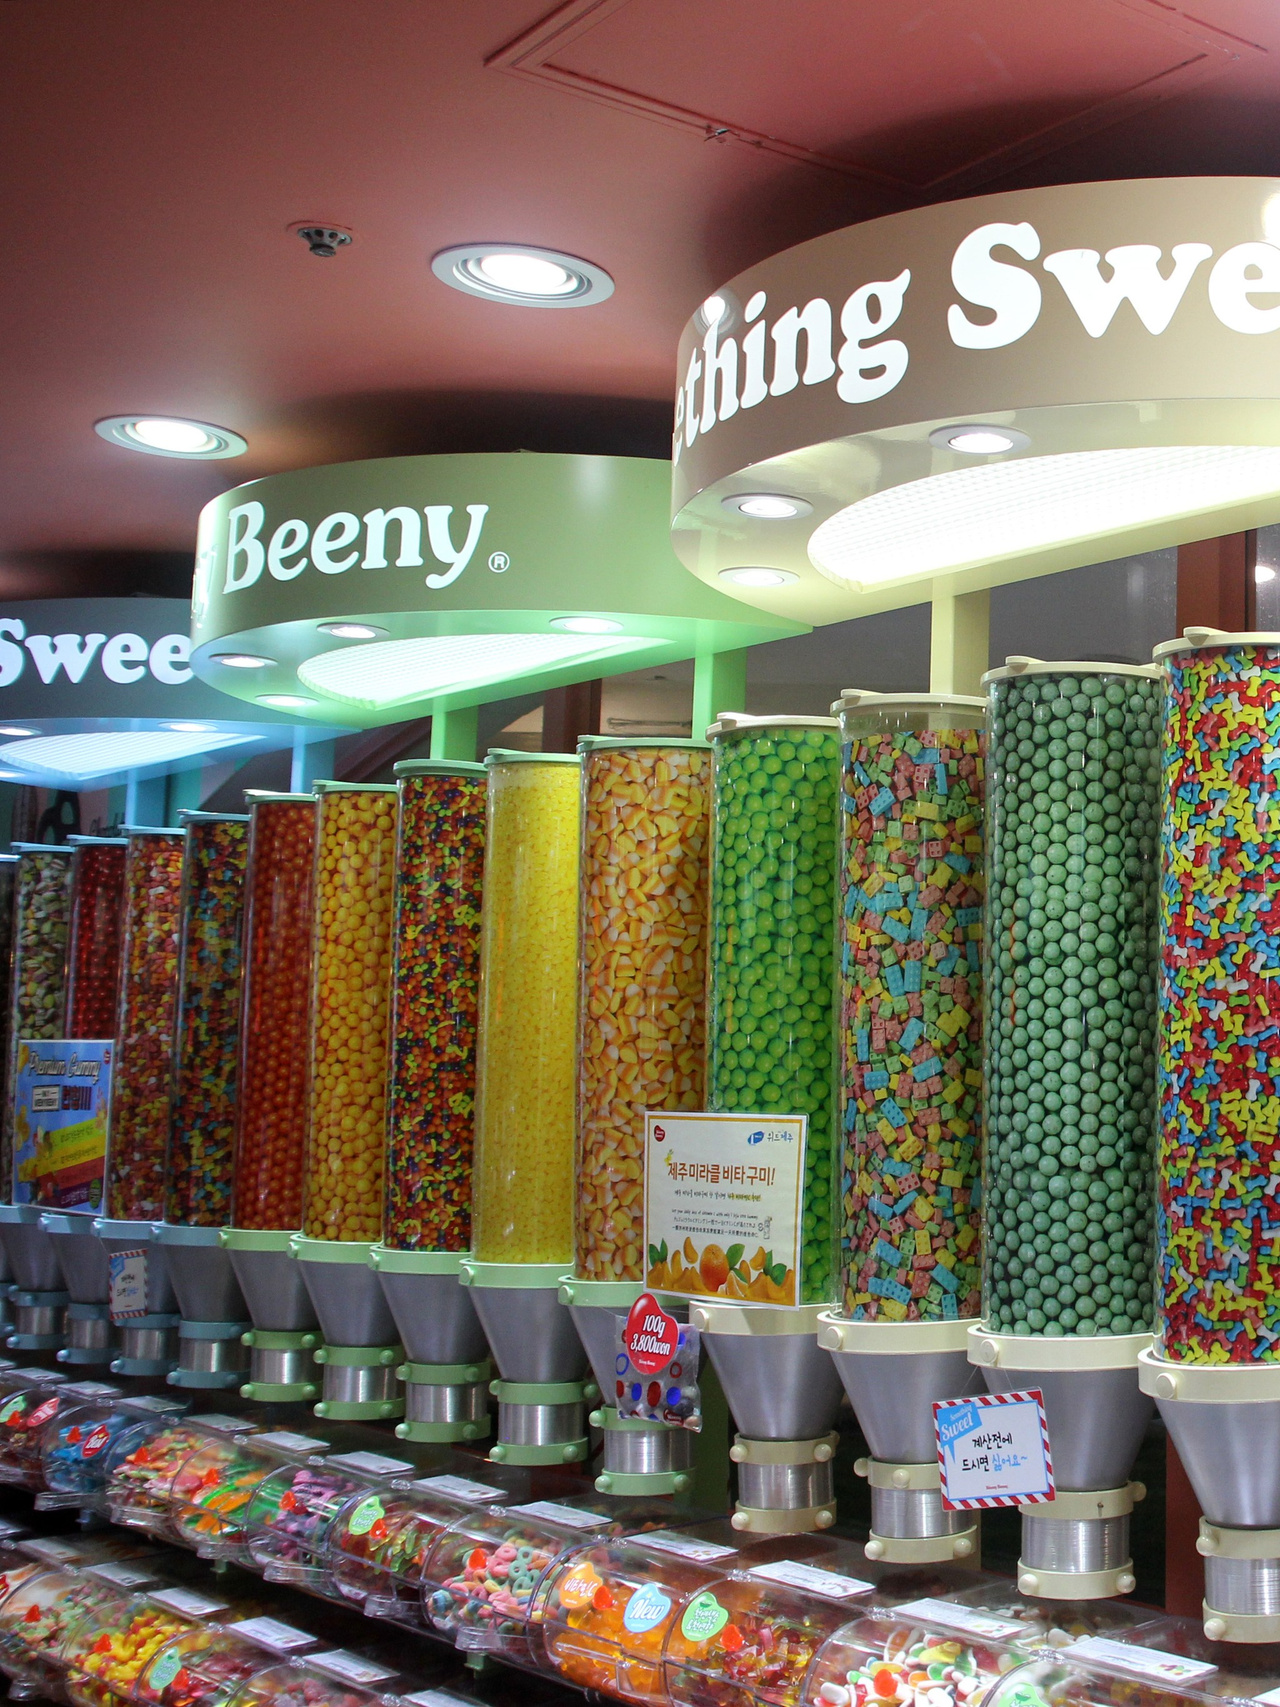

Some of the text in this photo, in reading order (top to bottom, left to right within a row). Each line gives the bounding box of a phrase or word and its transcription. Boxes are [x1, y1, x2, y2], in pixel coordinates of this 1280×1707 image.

[222, 500, 490, 590] Beeny
[642, 1314, 666, 1338] 100g
[630, 1333, 670, 1355] 3,800won
[940, 1411, 973, 1441] Sweet
[961, 1454, 989, 1471] 드시면
[629, 1599, 664, 1619] New
